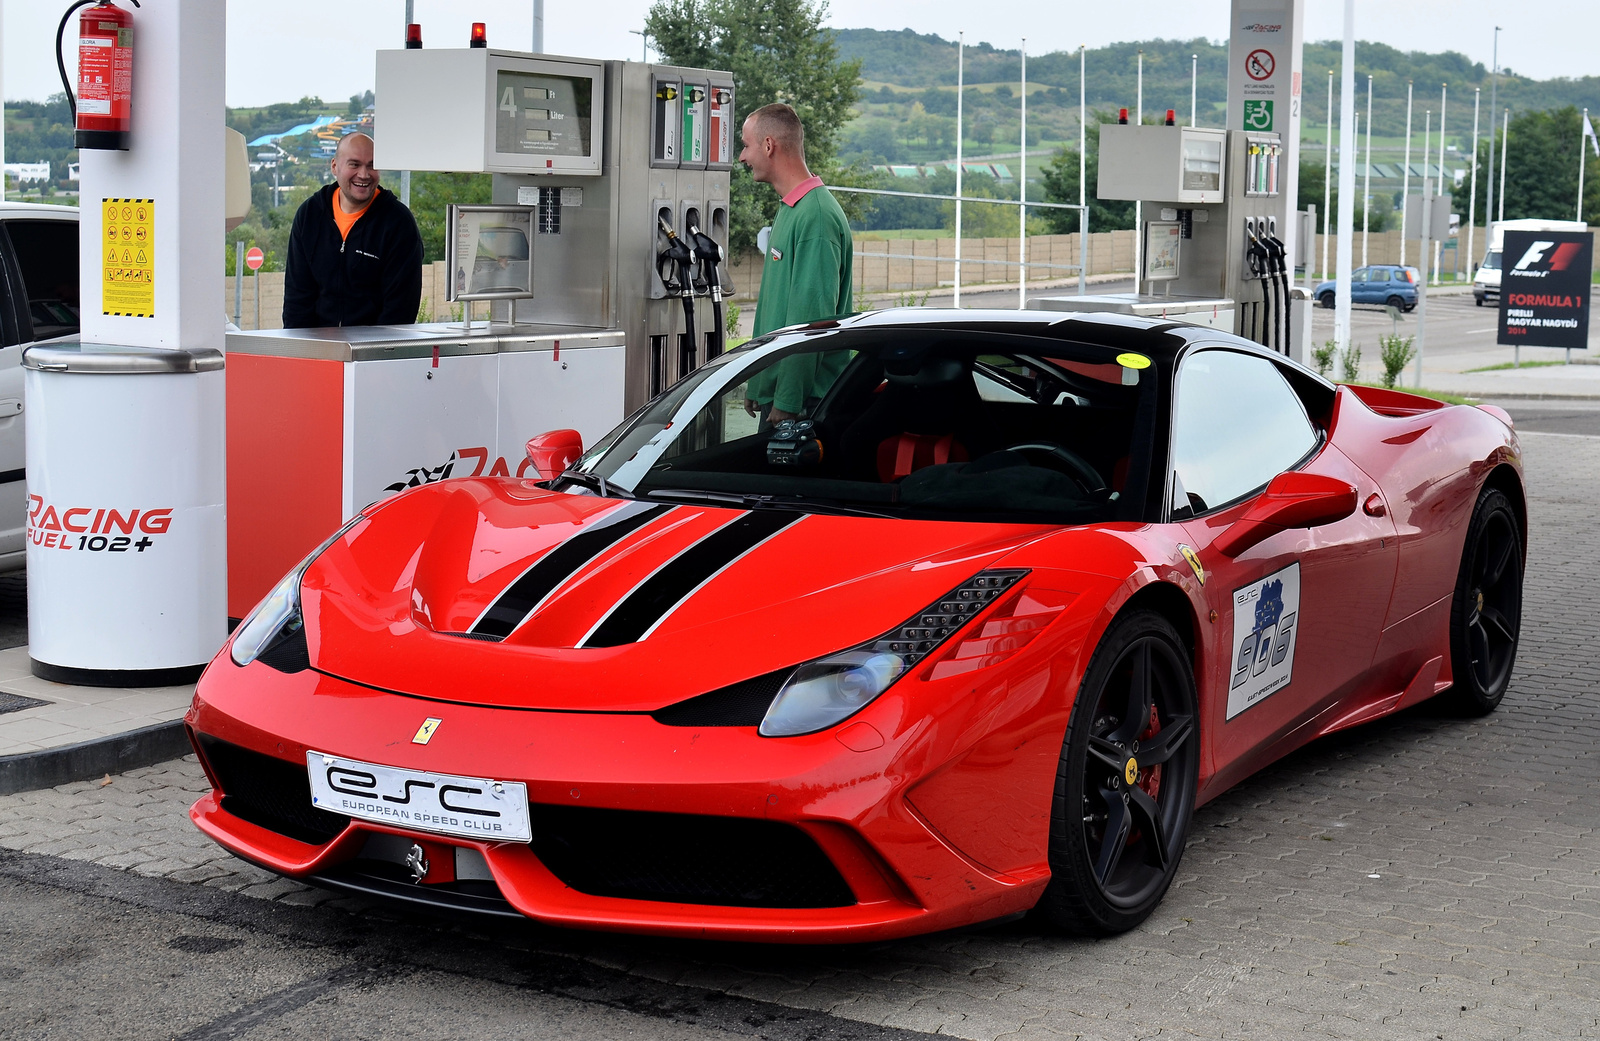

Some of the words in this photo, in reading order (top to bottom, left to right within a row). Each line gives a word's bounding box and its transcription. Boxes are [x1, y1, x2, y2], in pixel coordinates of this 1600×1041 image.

[500, 86, 517, 117] 4
[549, 90, 556, 99] Ft
[550, 111, 565, 120] Liter
[1293, 99, 1298, 117] 2
[1508, 294, 1573, 307] FORMULA
[1576, 296, 1581, 308] 1
[1507, 309, 1533, 317] PIRELLI
[1507, 318, 1541, 327] MAGYAR
[1507, 327, 1527, 335] 2014
[29, 493, 174, 535] RACING
[27, 528, 73, 550] FUEL
[78, 535, 153, 552] 102+
[1231, 611, 1296, 691] 906
[342, 799, 410, 819] EUROPEAN
[414, 812, 459, 826] SPEED
[463, 819, 502, 831] CLUB
